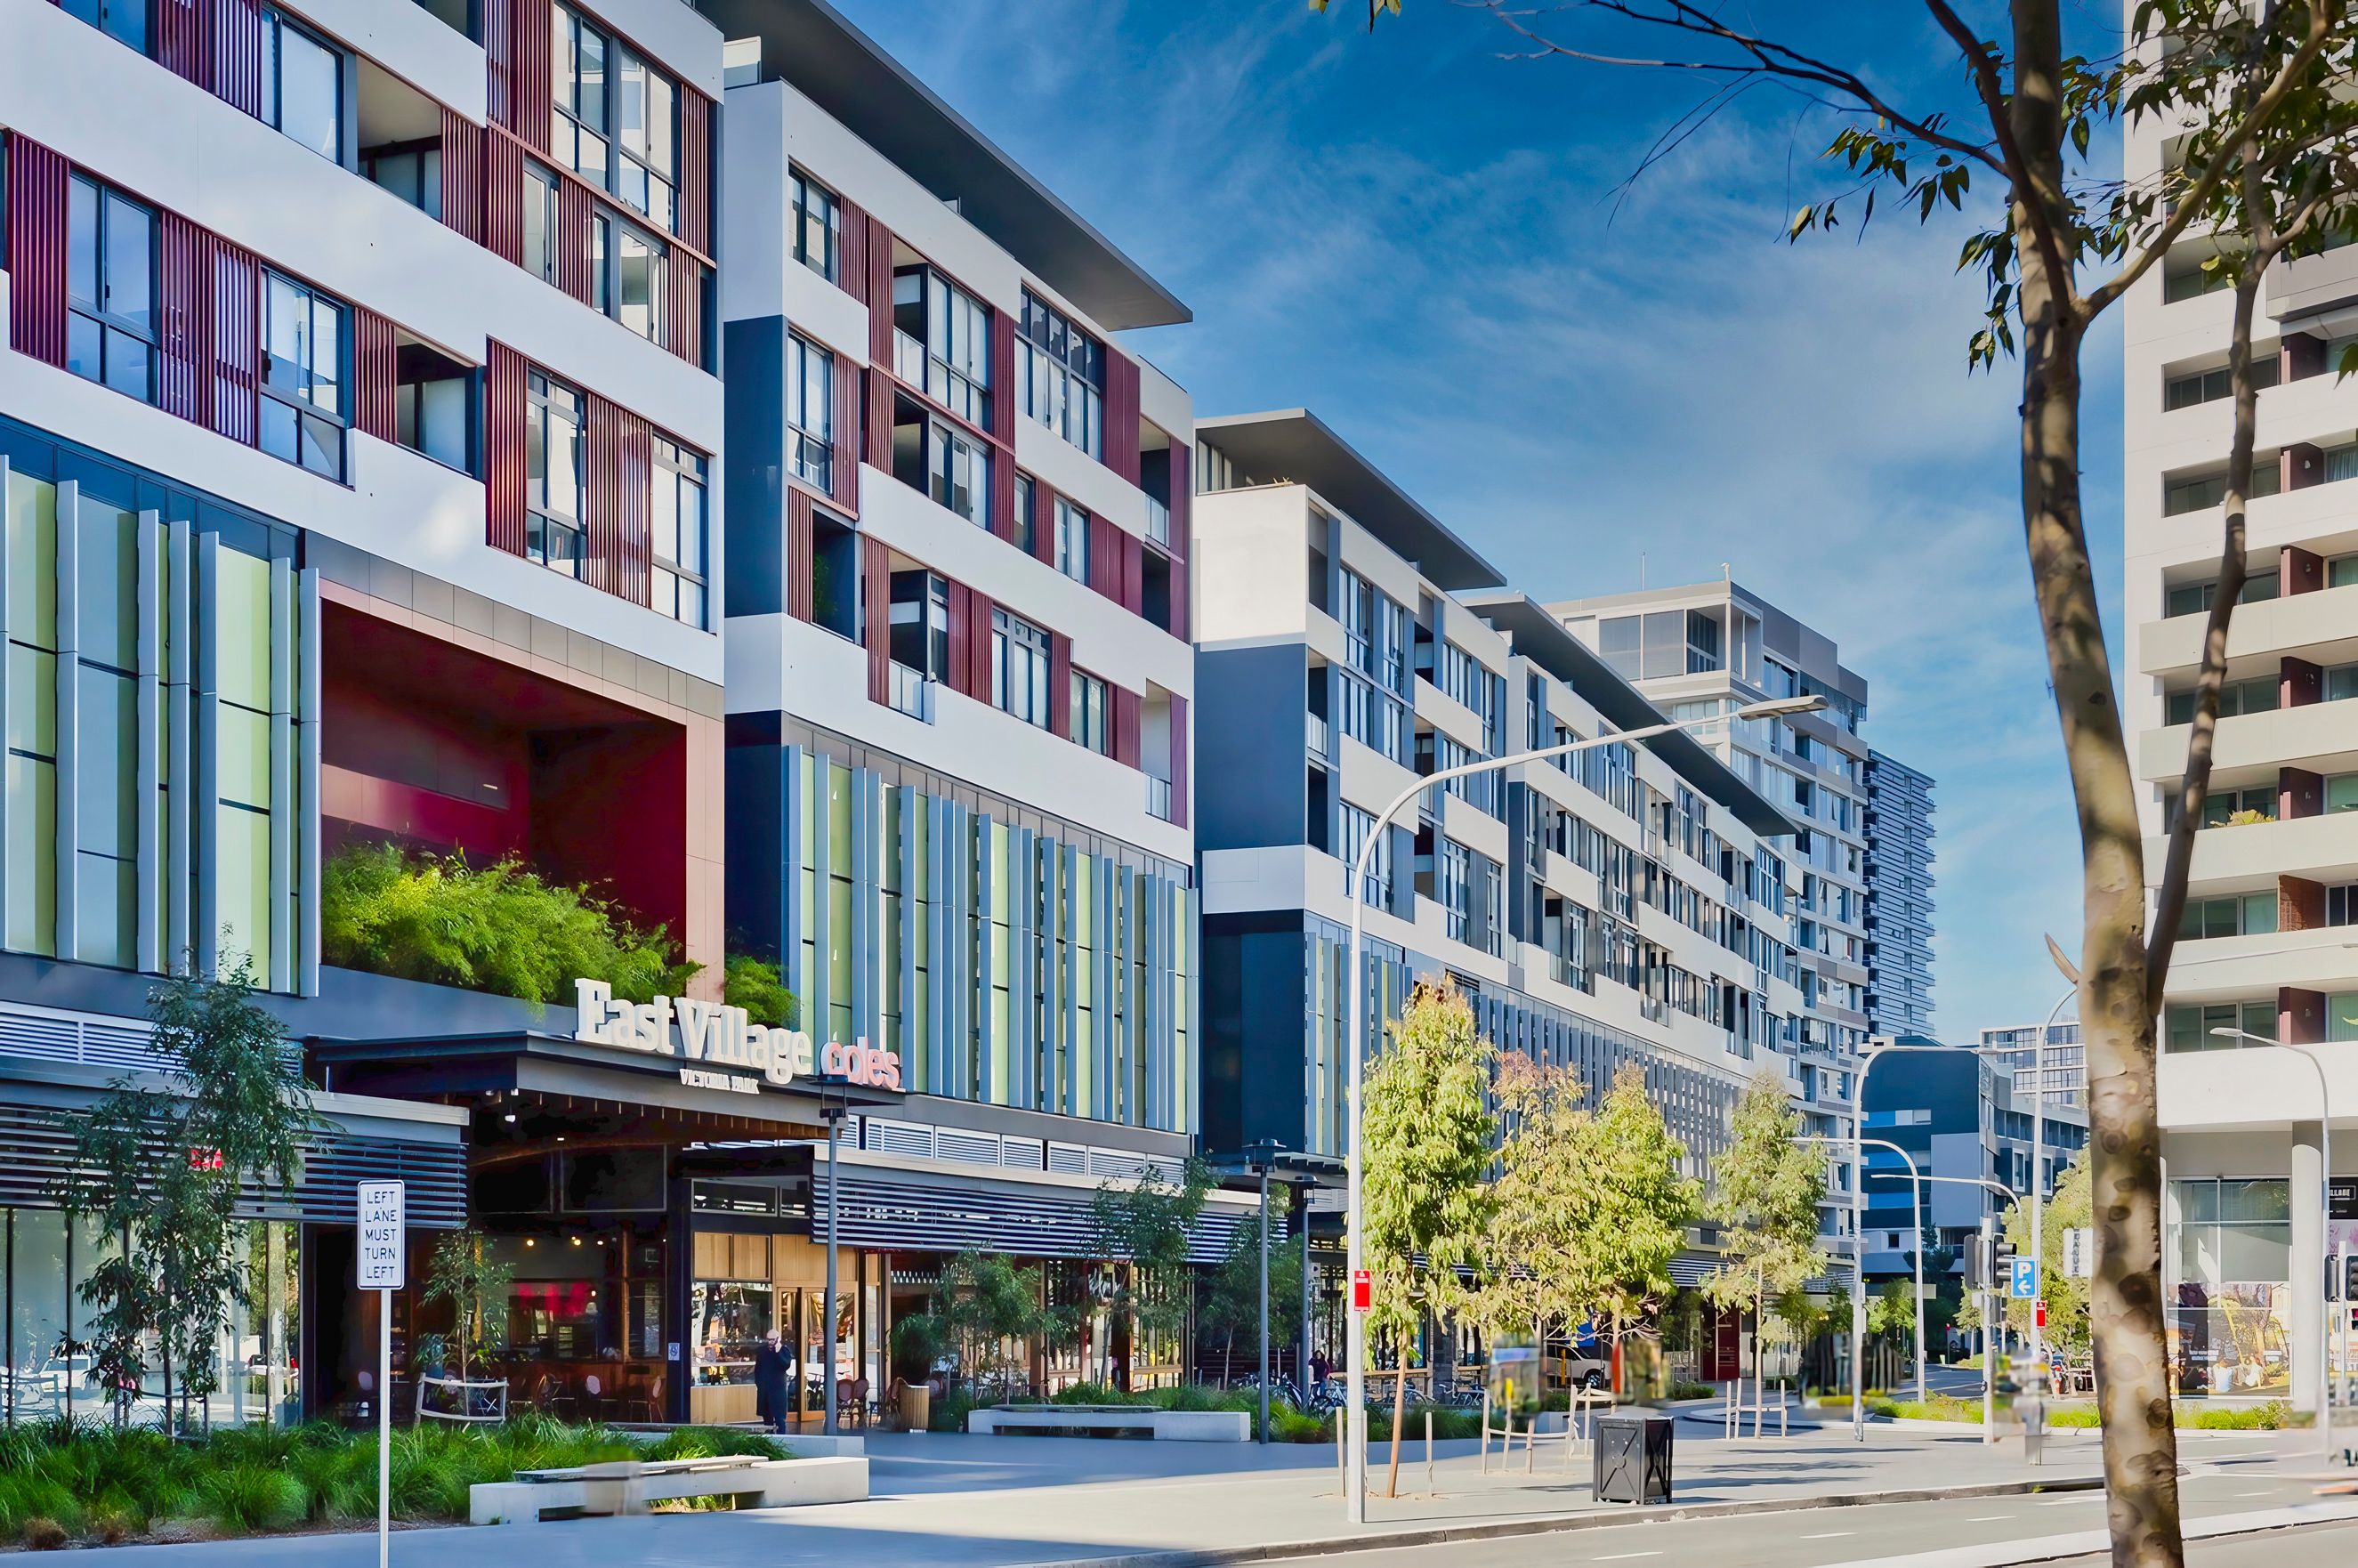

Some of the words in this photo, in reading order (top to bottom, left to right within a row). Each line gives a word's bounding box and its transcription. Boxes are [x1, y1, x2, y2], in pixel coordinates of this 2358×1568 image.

[575, 978, 675, 1055] East
[674, 997, 812, 1085] Village
[679, 1068, 731, 1091] VICTORIA
[731, 1075, 760, 1095] PARK
[367, 1191, 396, 1204] LEFT
[365, 1209, 397, 1223] LANE
[365, 1228, 397, 1241] MUST
[365, 1248, 396, 1260] TURN
[366, 1266, 395, 1279] LEFT
[2017, 1262, 2031, 1279] P
